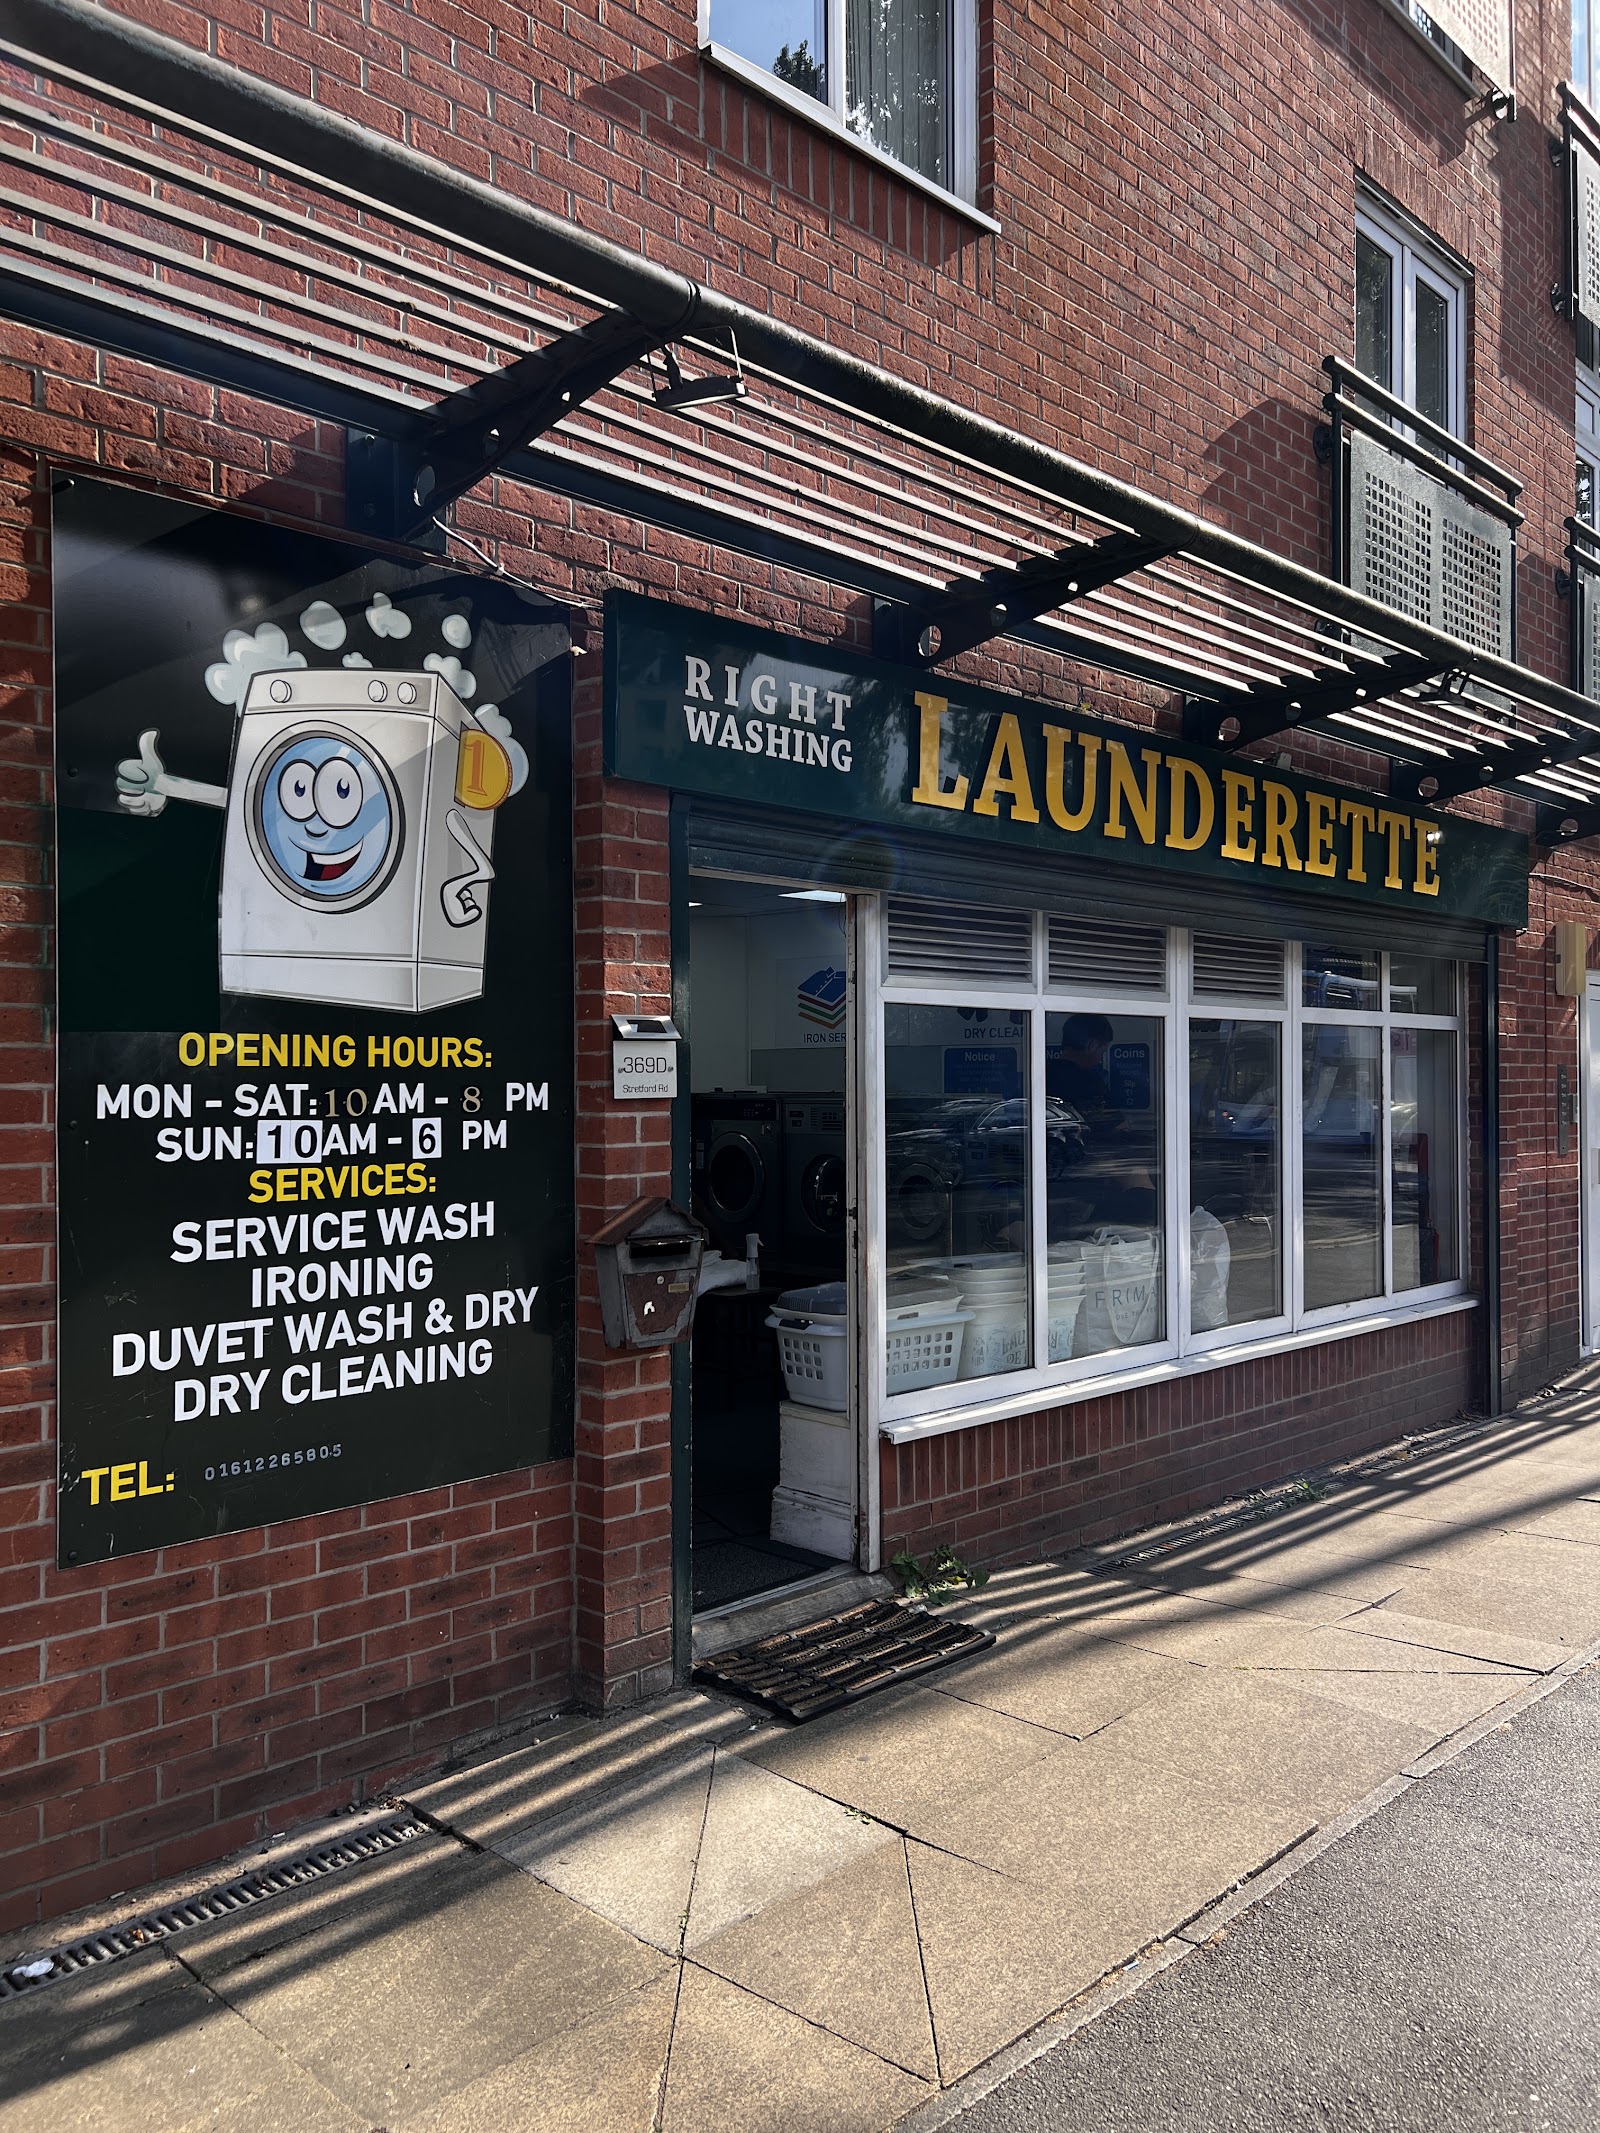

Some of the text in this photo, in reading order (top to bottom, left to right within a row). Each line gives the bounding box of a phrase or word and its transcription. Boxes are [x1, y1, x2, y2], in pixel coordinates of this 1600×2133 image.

[686, 656, 851, 732] RIGHT
[684, 704, 853, 772] WASHING
[912, 690, 1440, 897] LAUNDERETTE
[180, 1033, 491, 1068] OPENING HOURS:
[803, 1033, 826, 1043] IRON
[964, 1027, 986, 1039] DRY
[623, 1056, 667, 1074] 369D
[964, 1051, 996, 1062] Notice
[1113, 1047, 1145, 1059] Coins
[97, 1084, 192, 1119] MON
[233, 1083, 317, 1117] SAT:
[462, 1086, 482, 1113] 8
[506, 1083, 549, 1112] PM
[622, 1084, 669, 1094] Stretford Rd
[418, 1123, 436, 1154] 6
[463, 1120, 507, 1151] PM
[248, 1163, 436, 1204] SERVICES:
[170, 1201, 495, 1263] SERVICE WASH
[252, 1253, 433, 1308] IRONING
[113, 1287, 539, 1377] DUVET WASH & DRY
[175, 1338, 493, 1422] DRY CLEANING
[82, 1444, 342, 1504] TEL: 01612265805
